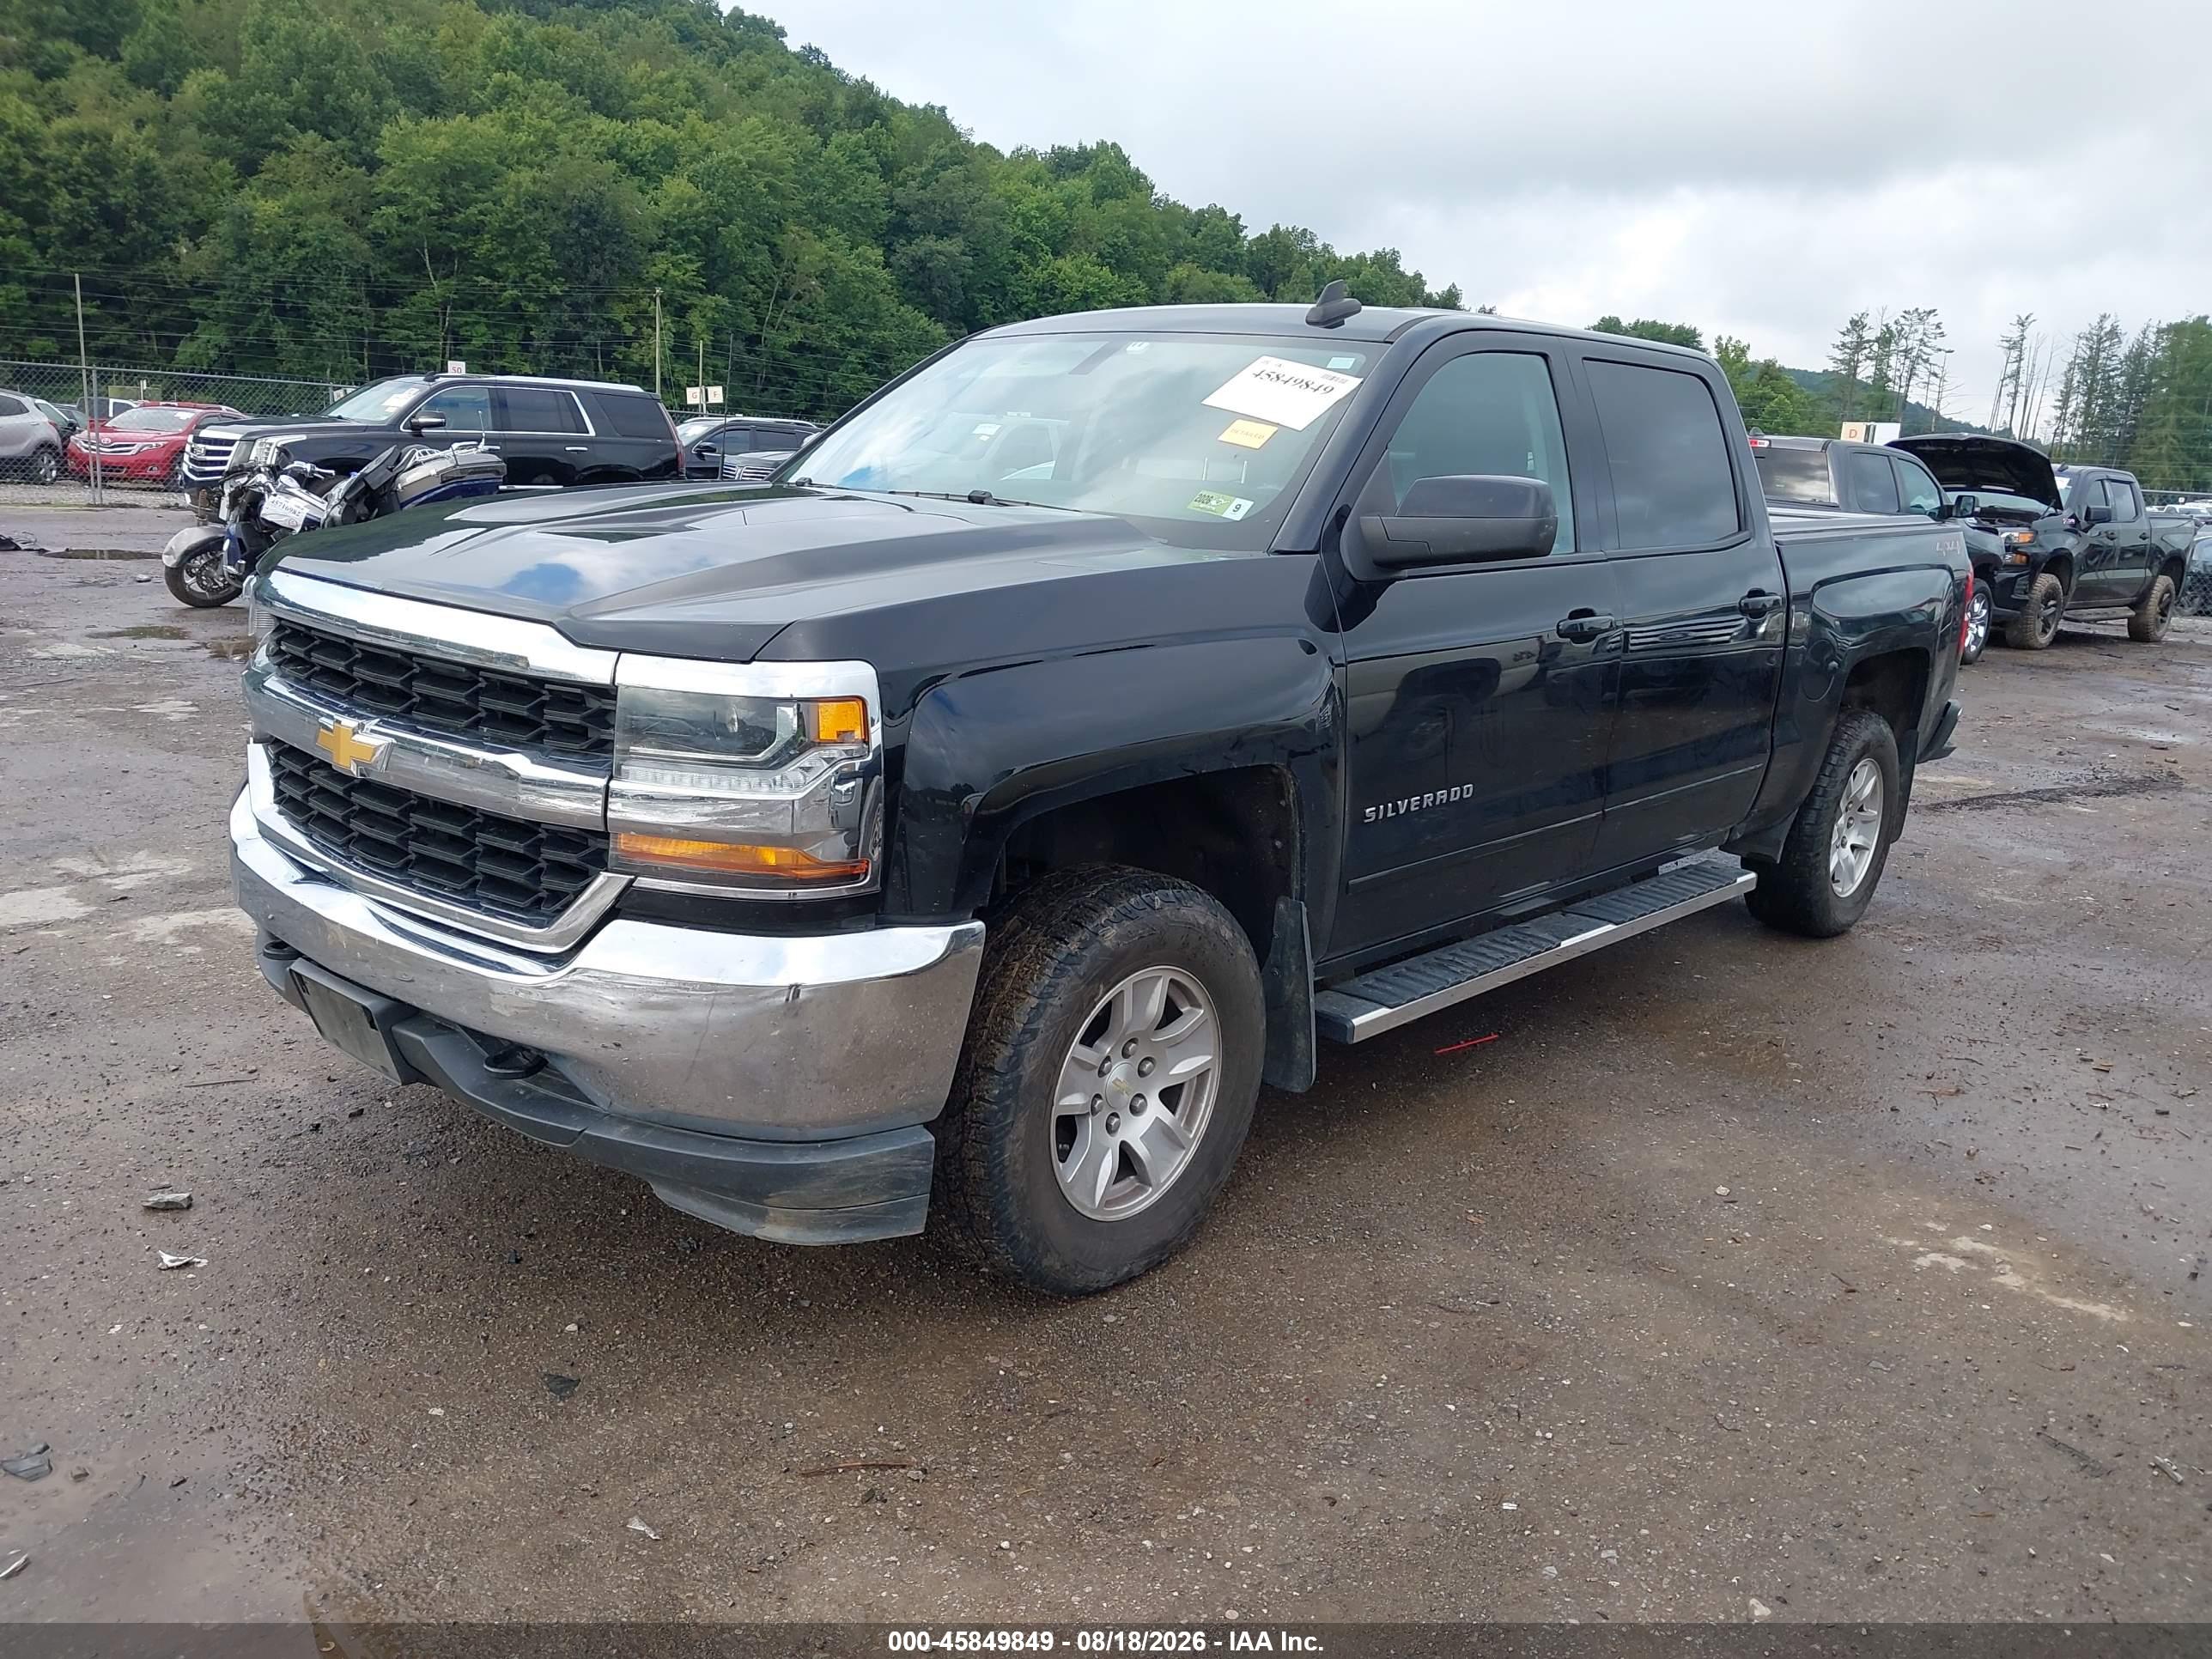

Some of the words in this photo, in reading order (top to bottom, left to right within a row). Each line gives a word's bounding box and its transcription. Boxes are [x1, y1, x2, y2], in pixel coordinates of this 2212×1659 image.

[1252, 369, 1335, 395] 45849849
[1849, 428, 1858, 439] D
[1364, 783, 1474, 823] SILVERADO
